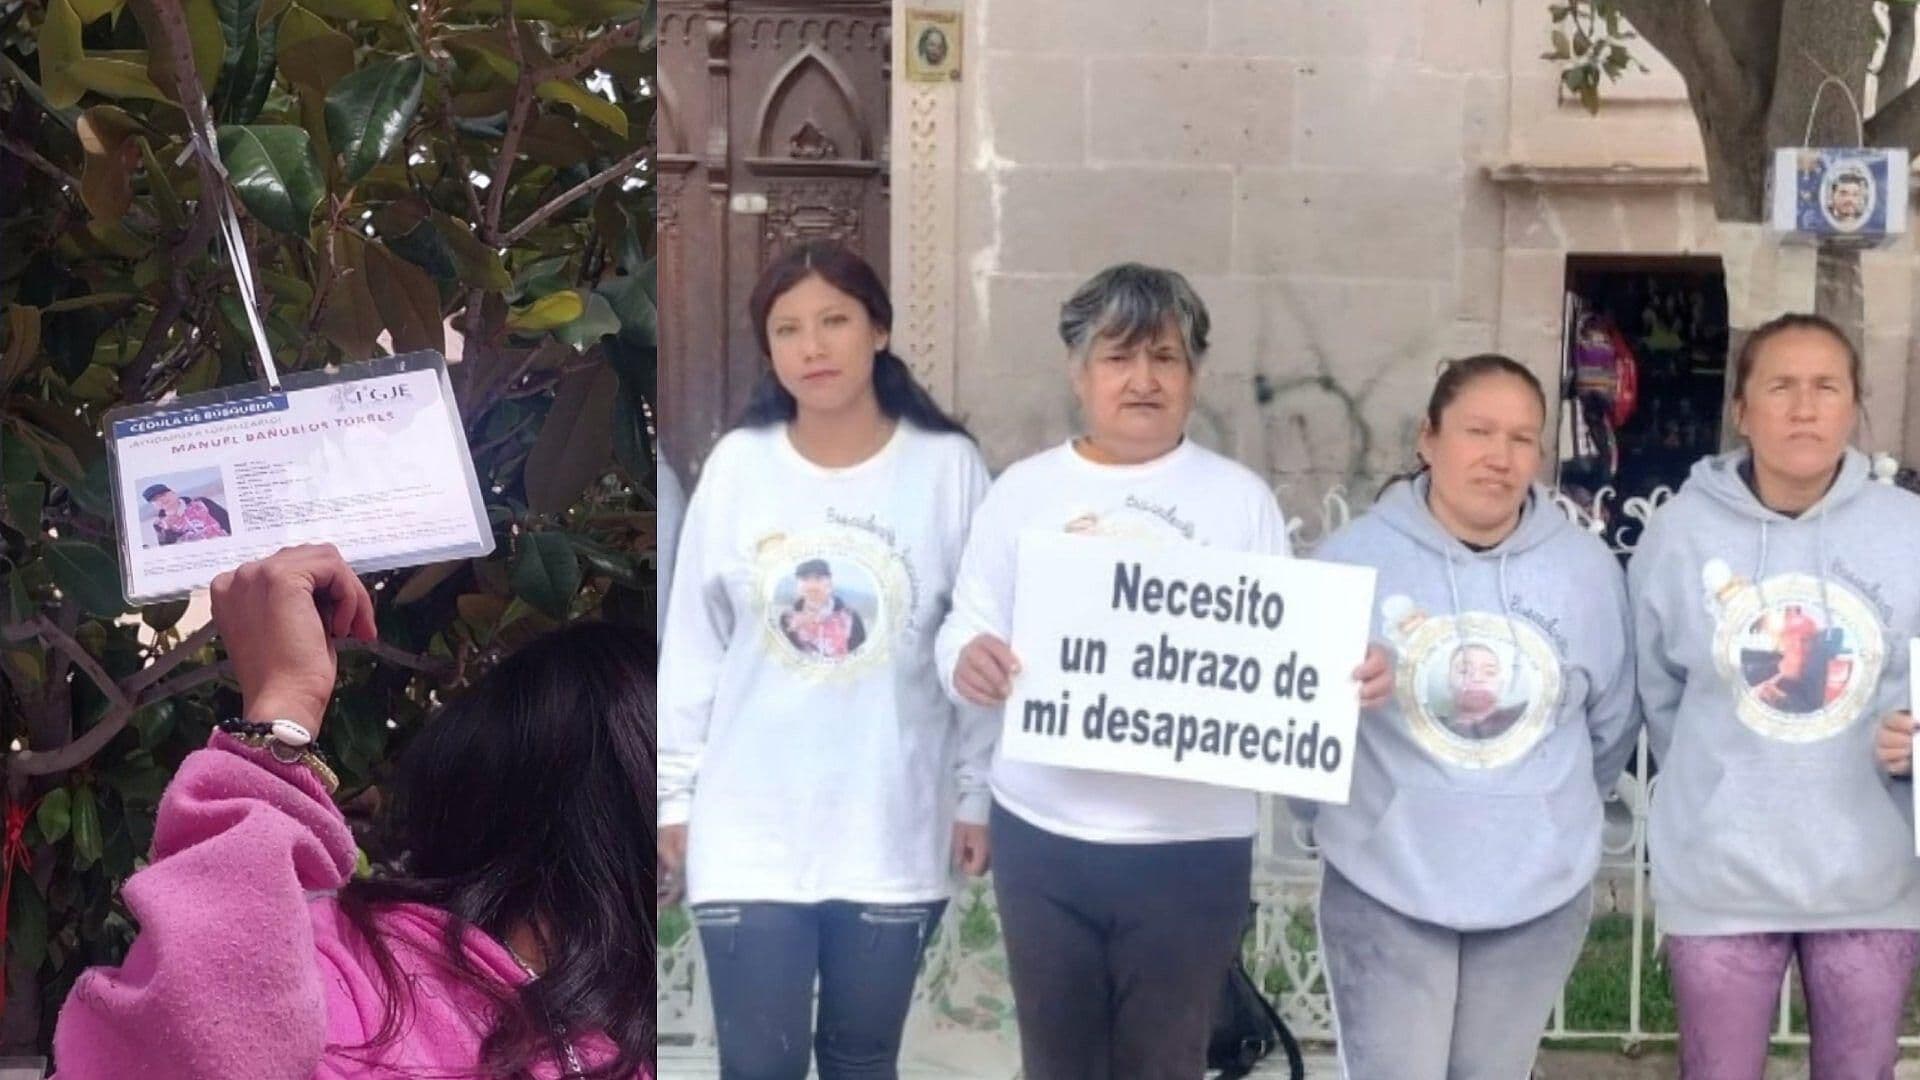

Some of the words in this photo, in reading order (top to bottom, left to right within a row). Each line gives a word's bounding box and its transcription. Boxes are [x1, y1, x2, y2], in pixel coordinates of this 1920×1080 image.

[171, 436, 239, 454] MANUEL
[334, 411, 395, 427] TORRES
[184, 412, 201, 424] DE
[1111, 561, 1285, 629] Necesito
[1060, 636, 1107, 674] un
[1131, 633, 1261, 694] abrazo
[1273, 650, 1320, 702] de
[1022, 690, 1070, 736] mi
[1082, 693, 1342, 773] desaparecido
